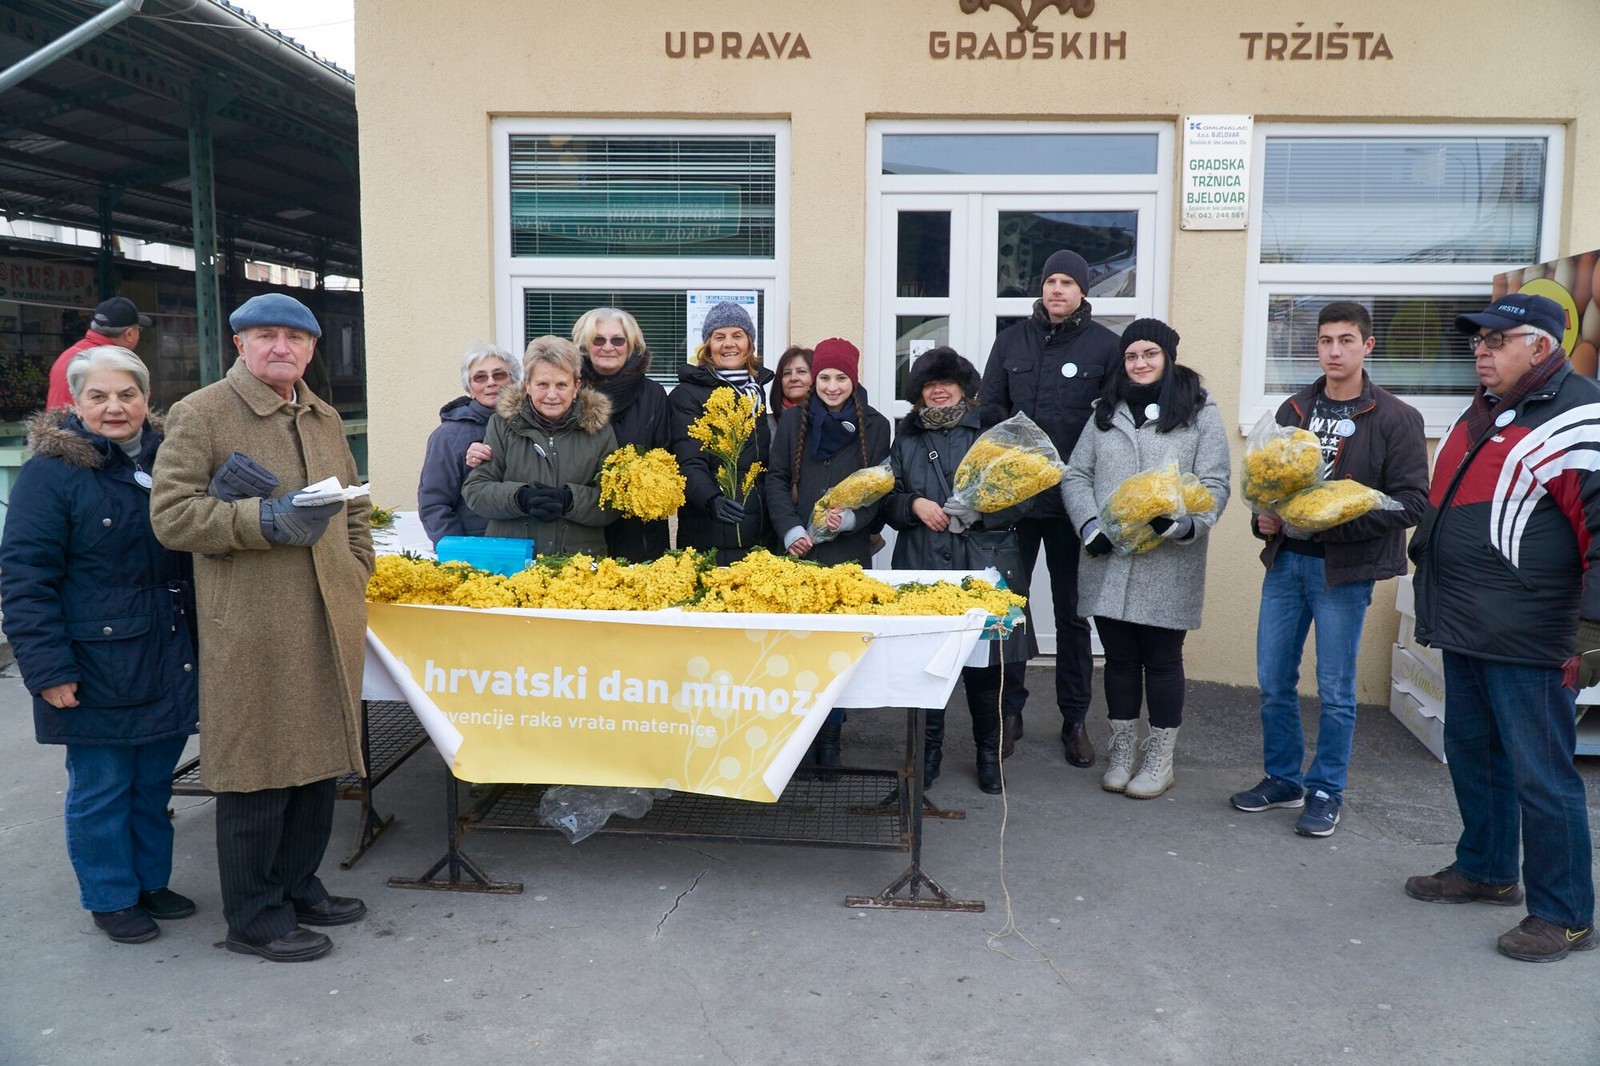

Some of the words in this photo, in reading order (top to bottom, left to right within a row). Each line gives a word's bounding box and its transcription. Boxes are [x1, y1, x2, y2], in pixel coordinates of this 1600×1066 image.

[664, 31, 811, 59] UPRAVA
[928, 30, 1127, 60] GRADSKIH
[1239, 21, 1394, 60] TRŽIŠTA
[1189, 158, 1245, 171] GRADSKA
[1192, 172, 1241, 187] TRŽNICA
[1187, 192, 1246, 204] BJELOVAR
[424, 659, 588, 700] hrvatski
[598, 669, 669, 705] dan
[681, 674, 823, 716] mimoz
[441, 709, 515, 731] vencije
[520, 711, 563, 729] raka
[567, 714, 616, 732] vrata
[622, 718, 717, 738] maternice
